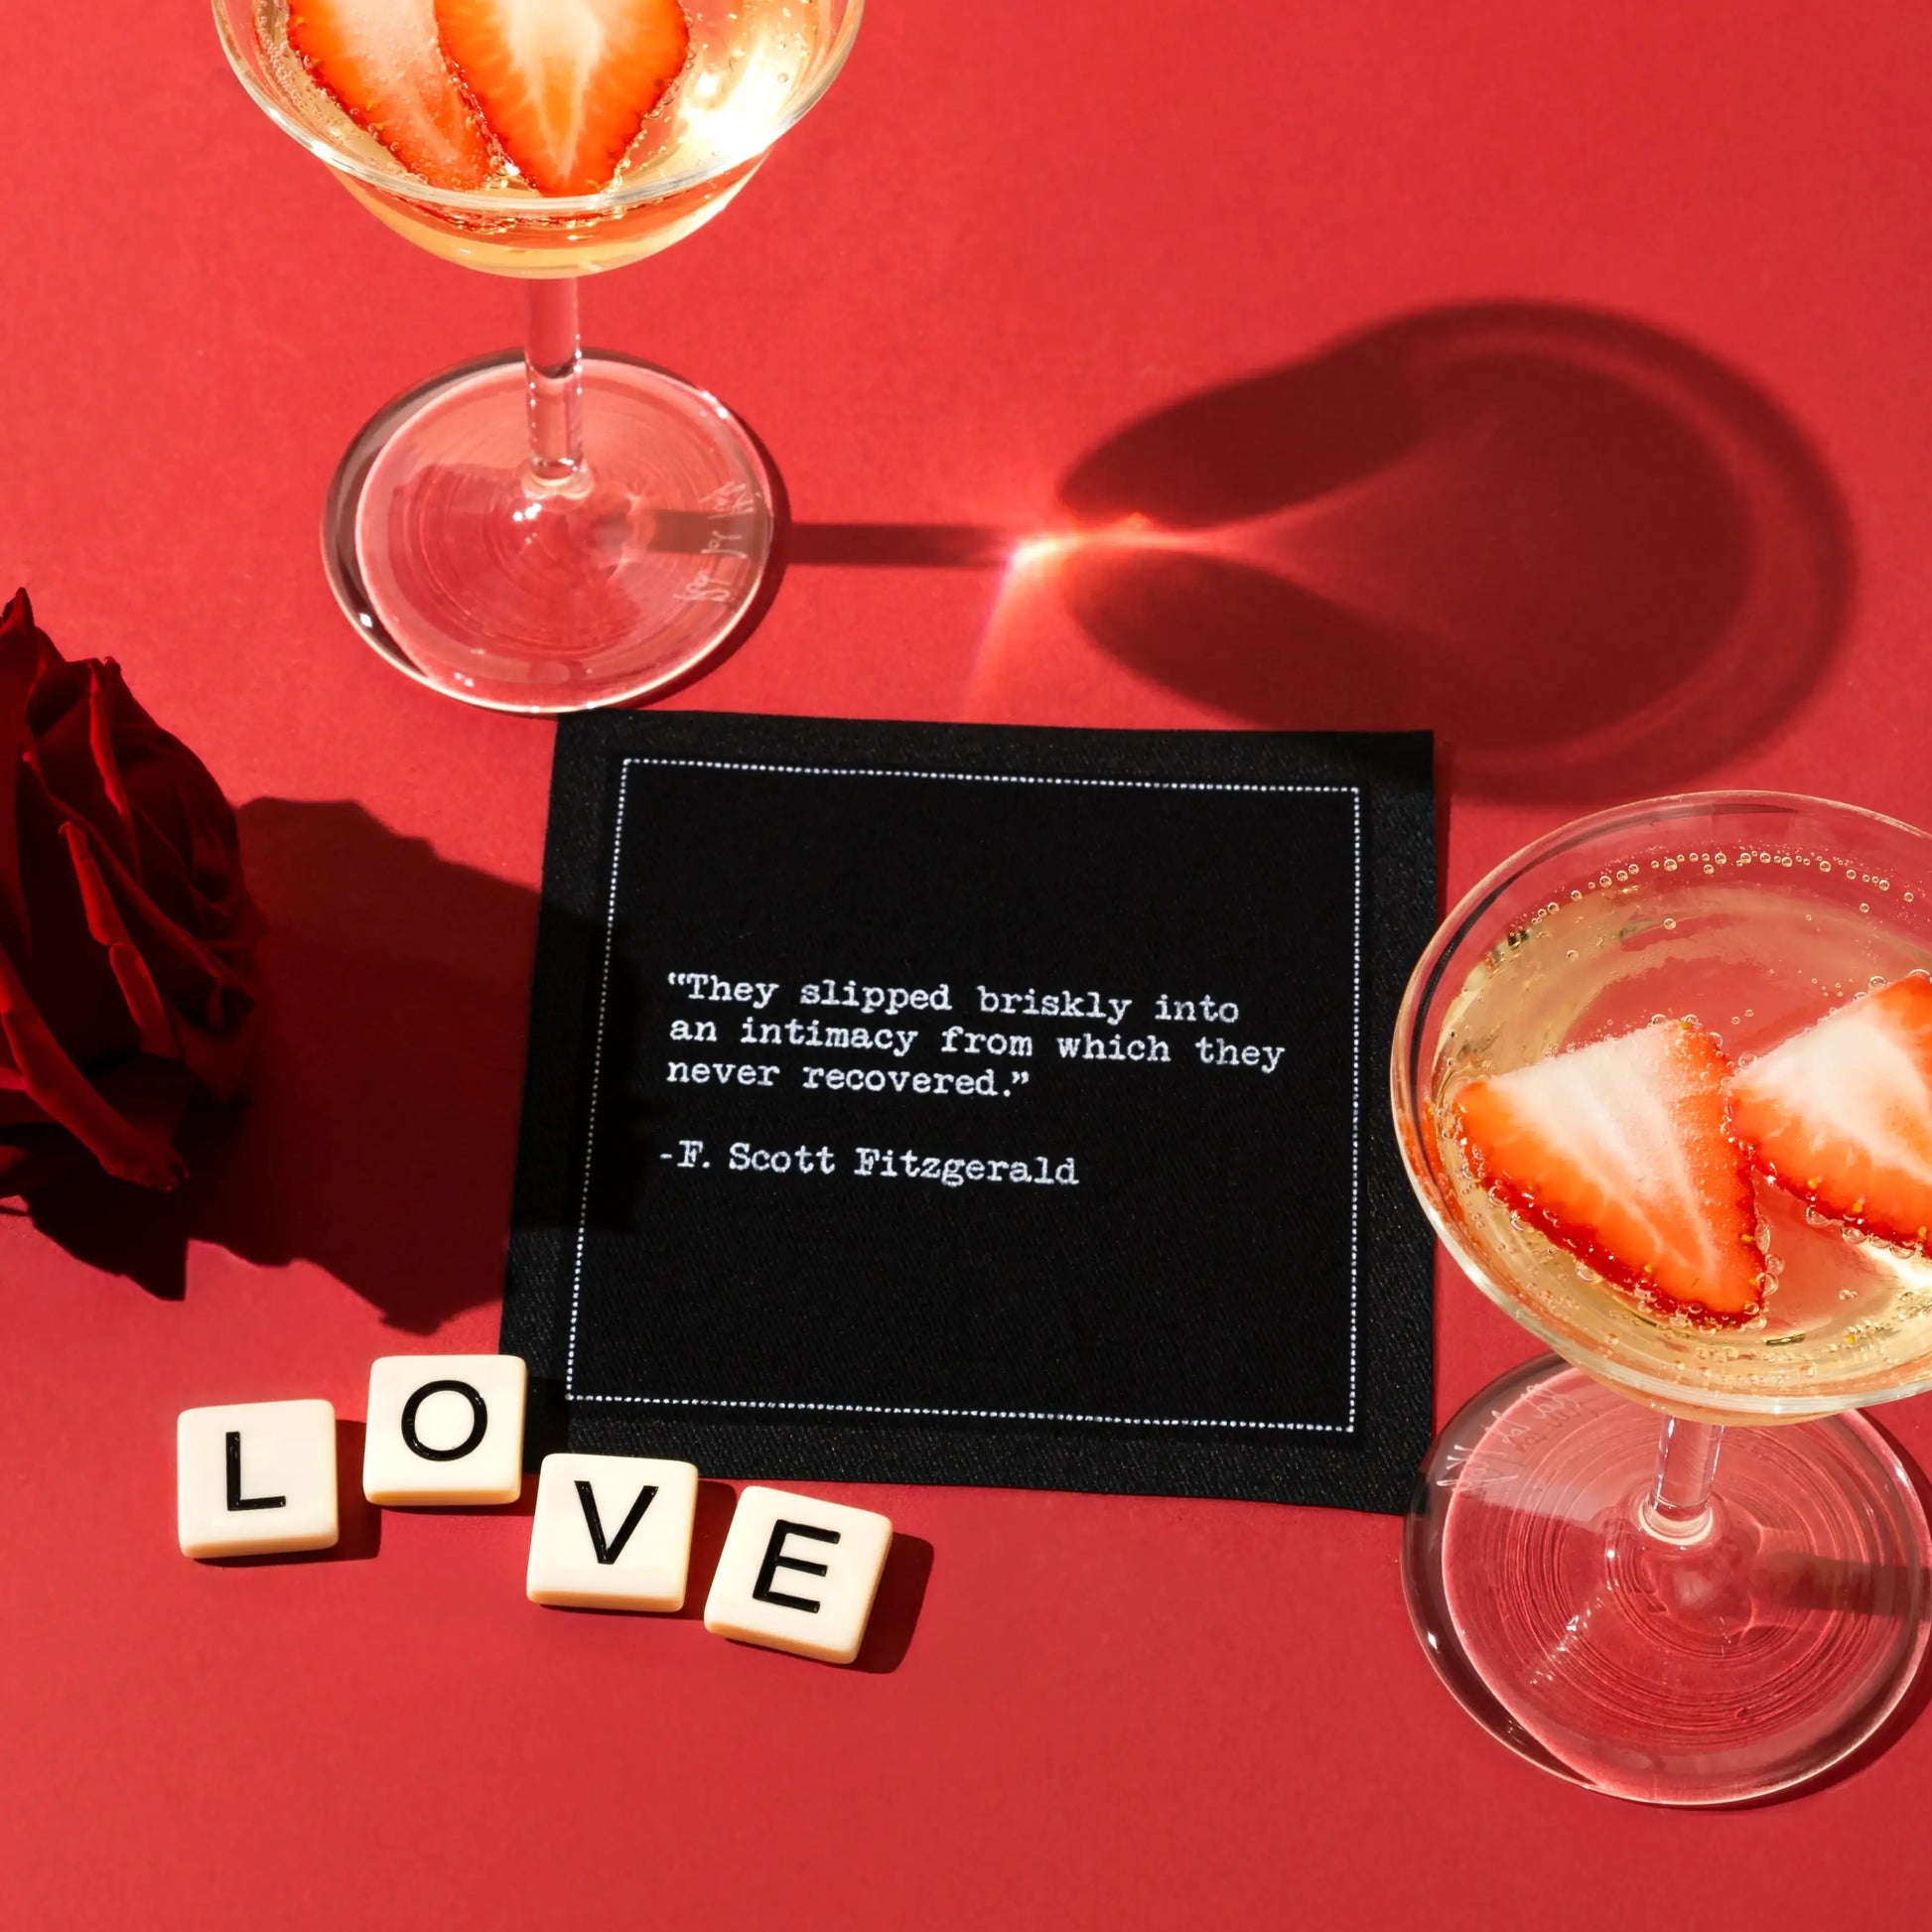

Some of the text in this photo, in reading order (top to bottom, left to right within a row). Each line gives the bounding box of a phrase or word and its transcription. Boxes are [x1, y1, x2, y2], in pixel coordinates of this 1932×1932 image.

[799, 978, 953, 1016] slipped
[976, 985, 1133, 1027] briskly
[1154, 993, 1239, 1024] into
[669, 1016, 1286, 1074] an intimacy from which they
[666, 1061, 1030, 1098] never recovered.”
[728, 1142, 836, 1174] Scott
[853, 1147, 1080, 1188] Fitzgerald
[225, 1379, 842, 1614] LOVE
